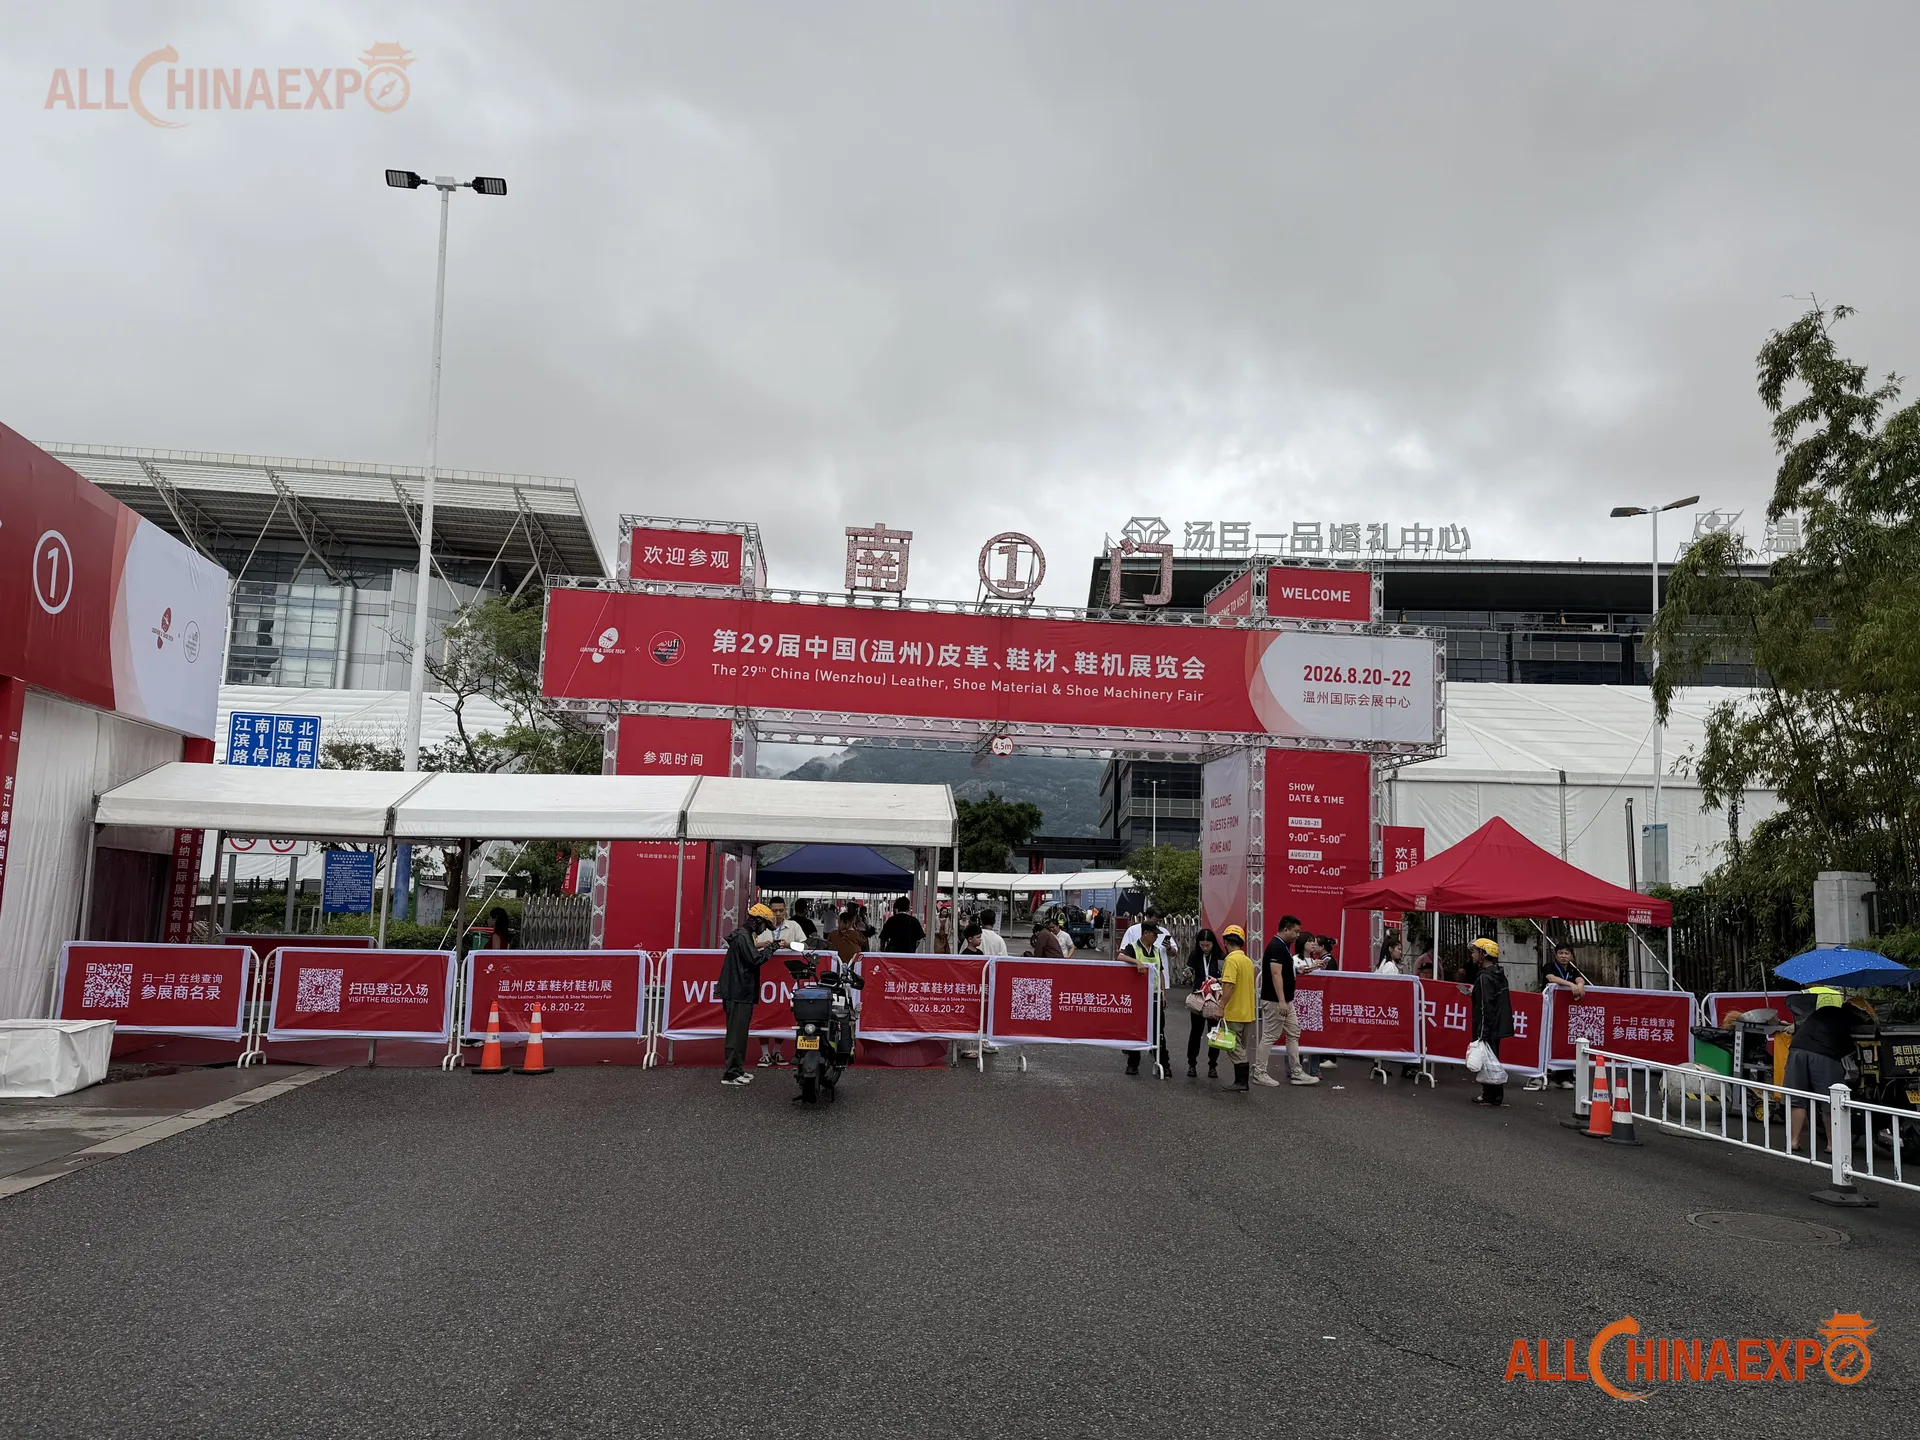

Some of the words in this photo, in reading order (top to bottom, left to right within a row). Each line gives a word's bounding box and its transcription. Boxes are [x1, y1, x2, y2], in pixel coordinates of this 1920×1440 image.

[1183, 521, 1471, 553] 汤臣一品婚礼中心
[643, 545, 729, 568] 欢迎参观
[1281, 586, 1351, 602] WELCOME
[712, 664, 736, 676] The
[742, 665, 766, 677] 29th
[771, 667, 810, 680] China
[814, 670, 886, 686] (Wenzhou)
[891, 675, 948, 690] Leather,
[953, 678, 986, 690] Shoe
[991, 680, 1047, 694] Material
[1052, 684, 1062, 696] &
[1066, 684, 1099, 697] Shoe
[1104, 686, 1173, 702] Machinery
[1177, 690, 1204, 702] Fair
[1303, 665, 1410, 687] 2026.8.20-22
[1303, 691, 1410, 708] 温州国际会展中心
[232, 717, 250, 764] 江滨路
[252, 719, 270, 767] 南1停
[275, 720, 294, 766] 瓯江路
[643, 750, 703, 766] 参观时间
[1288, 782, 1314, 792] SHOW
[1210, 794, 1232, 809] WELCOME
[1288, 794, 1312, 803] DATE
[1314, 795, 1320, 804] &
[1322, 796, 1344, 804] TIME
[1210, 818, 1226, 831] GUESTS
[1226, 816, 1238, 830] FROM
[1210, 842, 1222, 854] HOME
[1222, 840, 1232, 852] AND
[1395, 847, 1408, 872] 欢迎
[168, 828, 193, 944] 德纳国际展览有限公
[142, 973, 175, 983] 扫一扫
[179, 973, 222, 984] 在线查询
[498, 980, 613, 992] 温州皮革鞋材鞋机展
[141, 985, 221, 1000] 参展商名录
[349, 982, 428, 997] 扫码登记入场
[683, 981, 818, 1004] WEOM
[1059, 992, 1132, 1006] 扫码登记入场
[524, 1003, 585, 1012] 206.8.20-22
[909, 1004, 965, 1013] 2026.8.20-22
[1089, 1006, 1132, 1014] REGISTRATION
[1329, 1003, 1399, 1019] 扫码登记入场
[1329, 1016, 1344, 1024] VISIT
[1358, 1018, 1400, 1026] REGISTRATION
[1612, 1016, 1638, 1025] 扫一扫
[1641, 1017, 1674, 1028] 在线查询
[1612, 1027, 1674, 1042] 参展商名录
